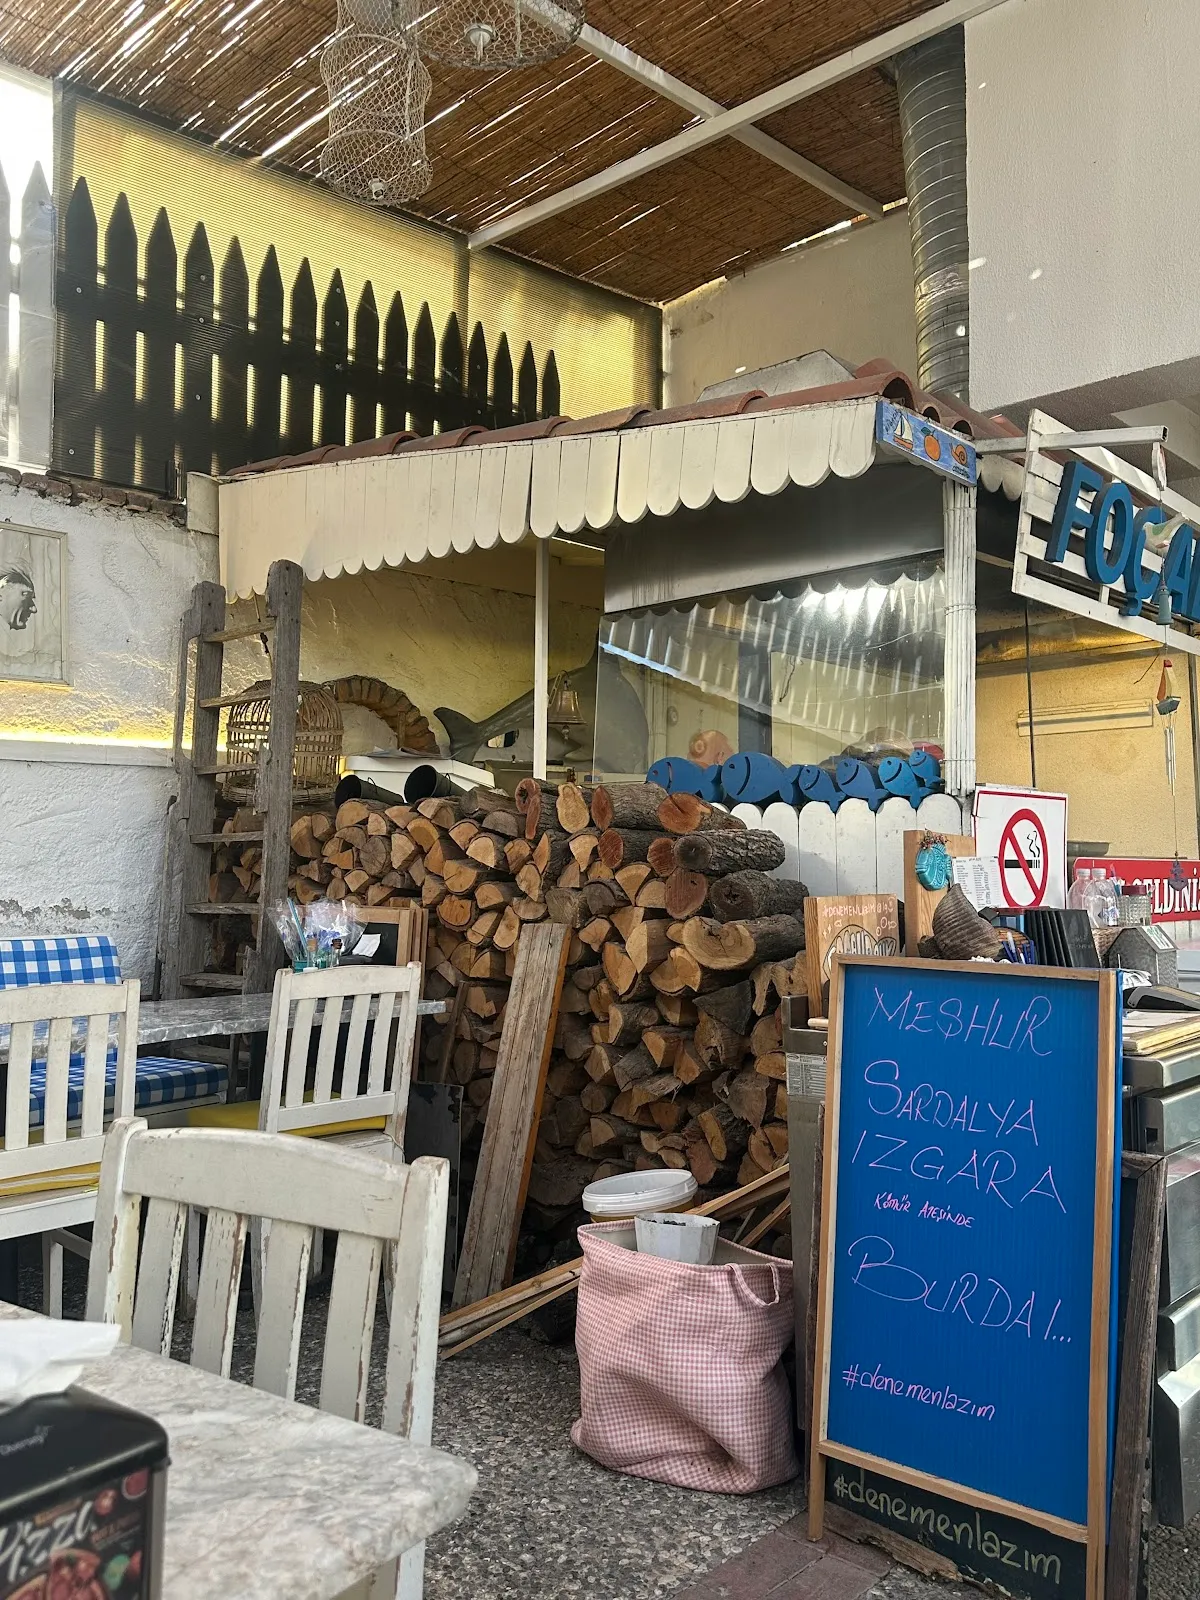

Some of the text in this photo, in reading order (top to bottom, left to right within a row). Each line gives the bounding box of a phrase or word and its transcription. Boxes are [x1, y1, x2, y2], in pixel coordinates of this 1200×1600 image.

[1046, 460, 1200, 622] FOÇA
[867, 986, 1053, 1056] MEŞHUR
[864, 1059, 1039, 1147] SARDALYA
[851, 1129, 1067, 1214] IZGARA
